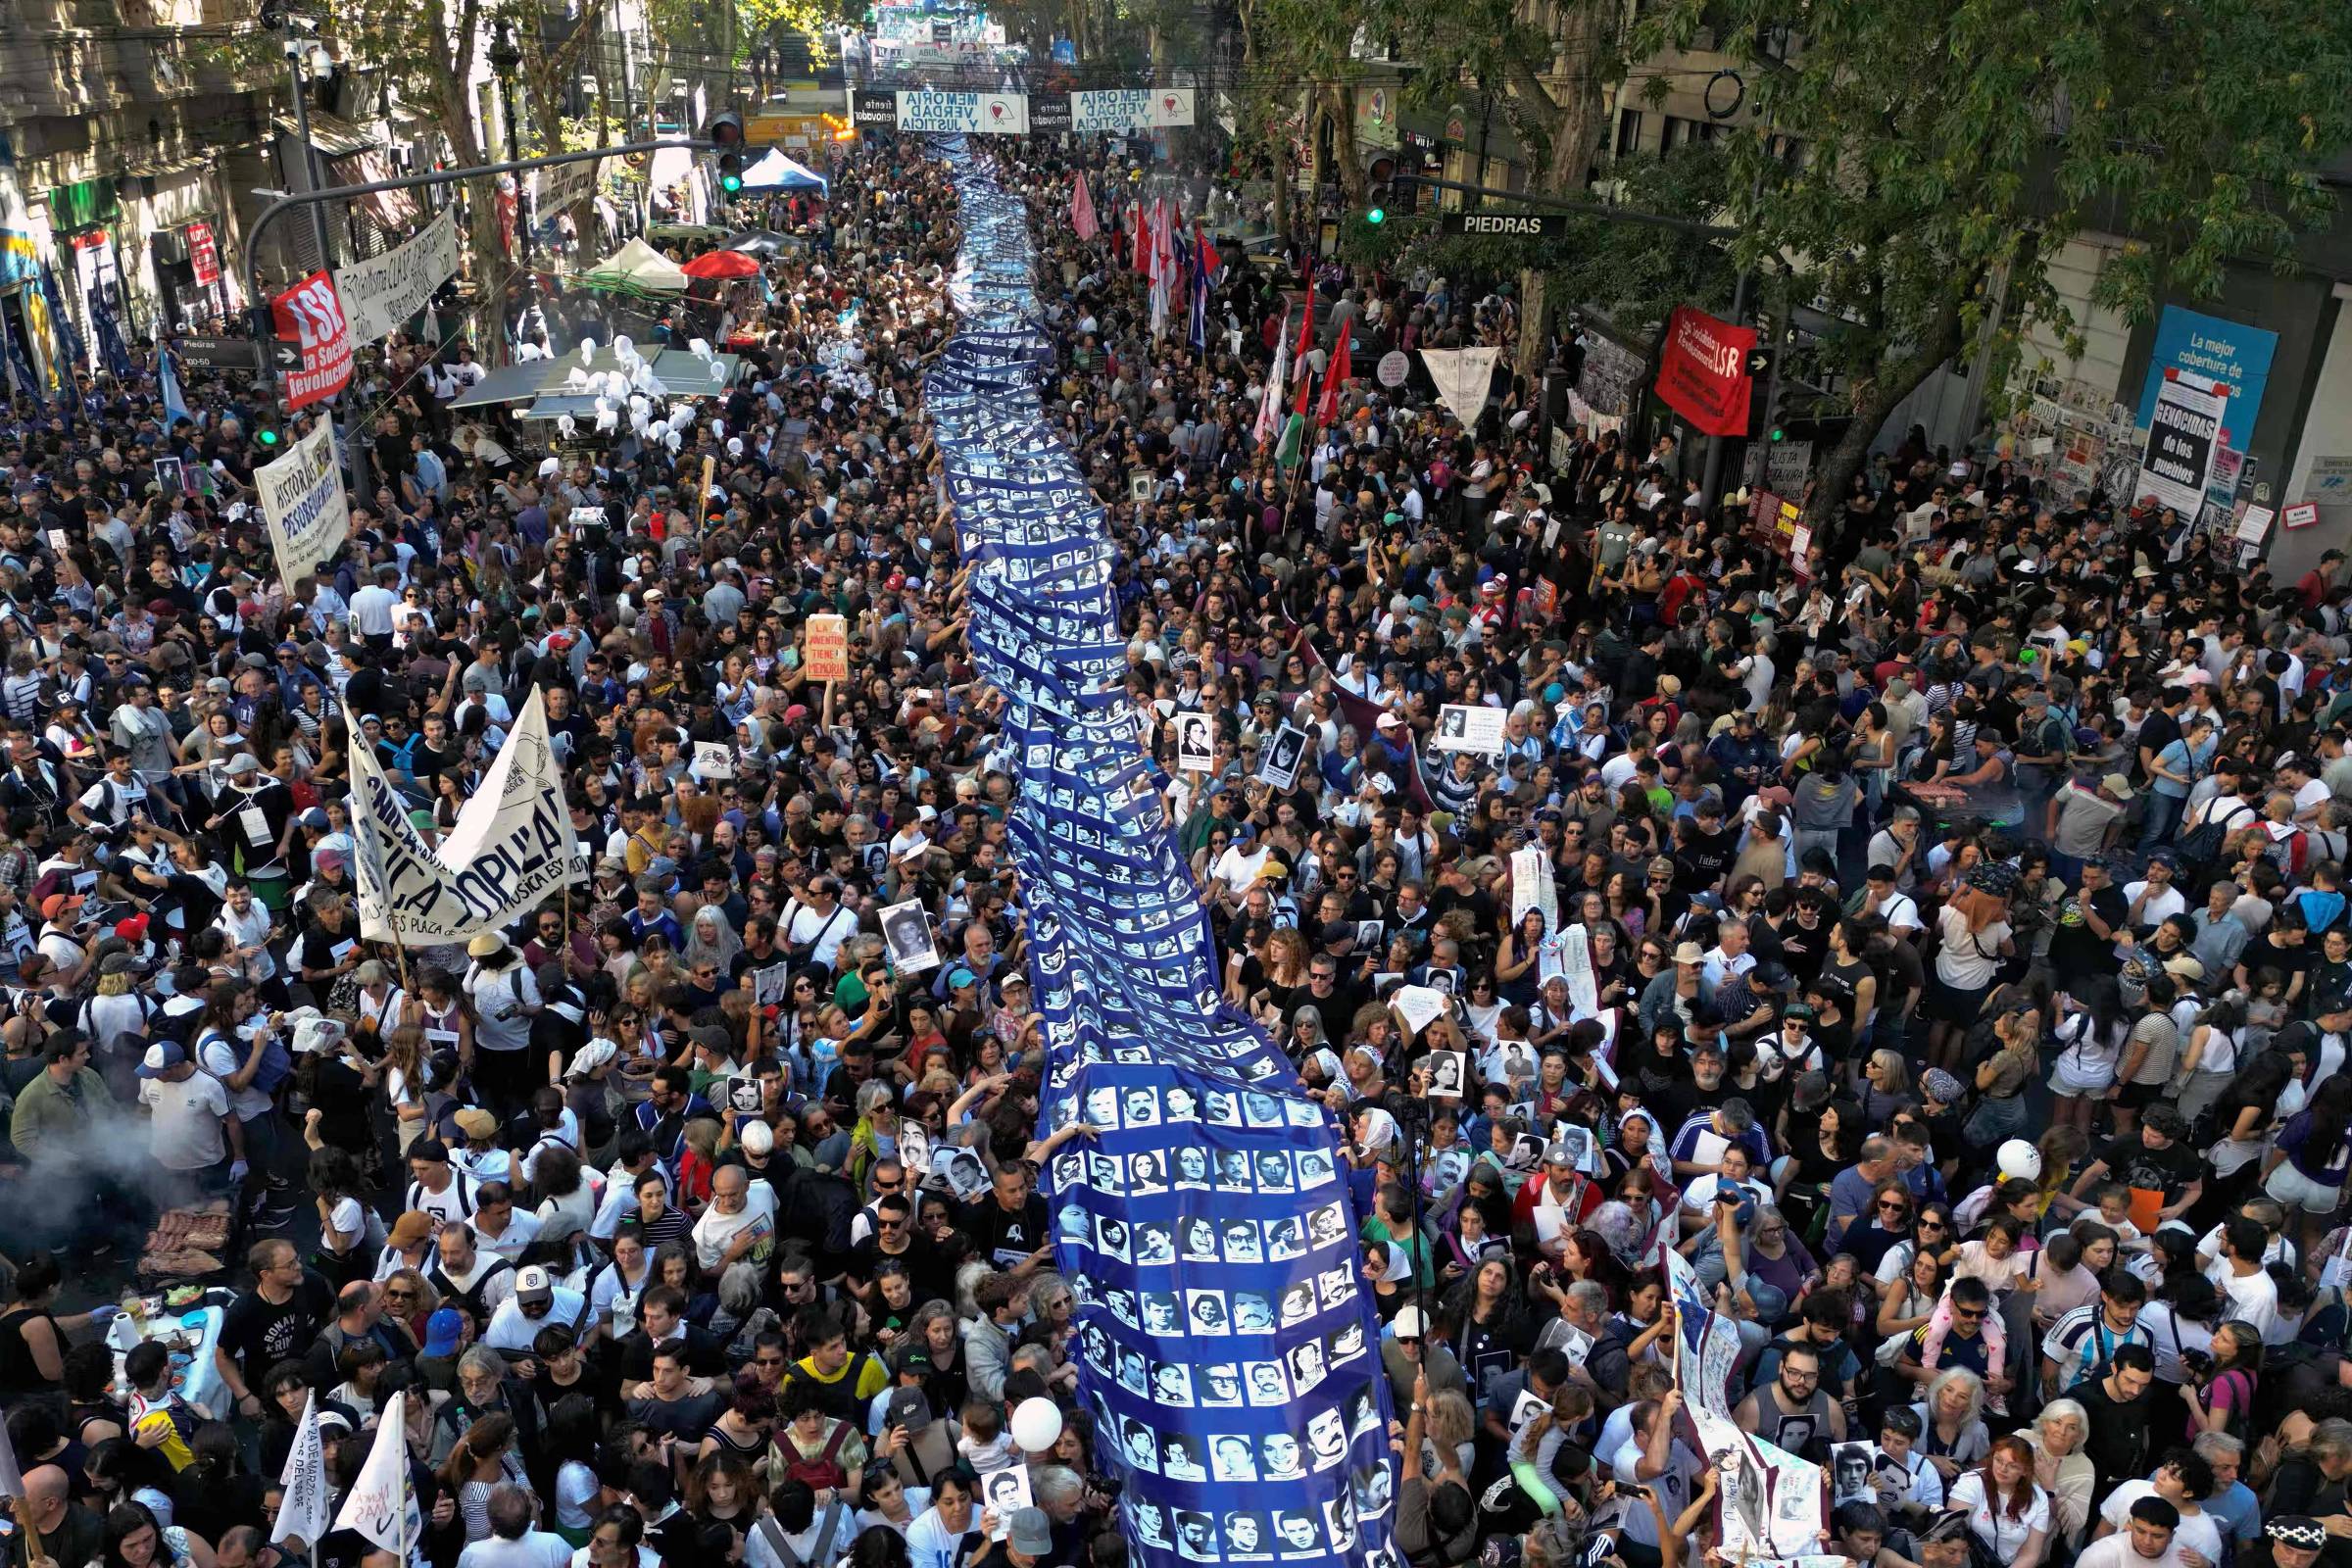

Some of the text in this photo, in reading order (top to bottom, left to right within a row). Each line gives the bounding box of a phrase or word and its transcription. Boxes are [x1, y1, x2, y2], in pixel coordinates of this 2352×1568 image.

[1464, 217, 1542, 233] PIEDRAS
[183, 340, 216, 349] Piedras
[2190, 332, 2235, 357] La mejor
[1714, 342, 1740, 378] LSR
[2179, 349, 2242, 378] cobertura de
[2155, 402, 2216, 441] GENOCIDAS
[2162, 434, 2176, 451] de
[2177, 439, 2193, 459] los
[2153, 458, 2195, 484] pueblos
[815, 624, 828, 633] LA
[811, 649, 834, 660] TIENE
[808, 662, 846, 675] MEMORIA
[411, 917, 442, 935] PLAZA
